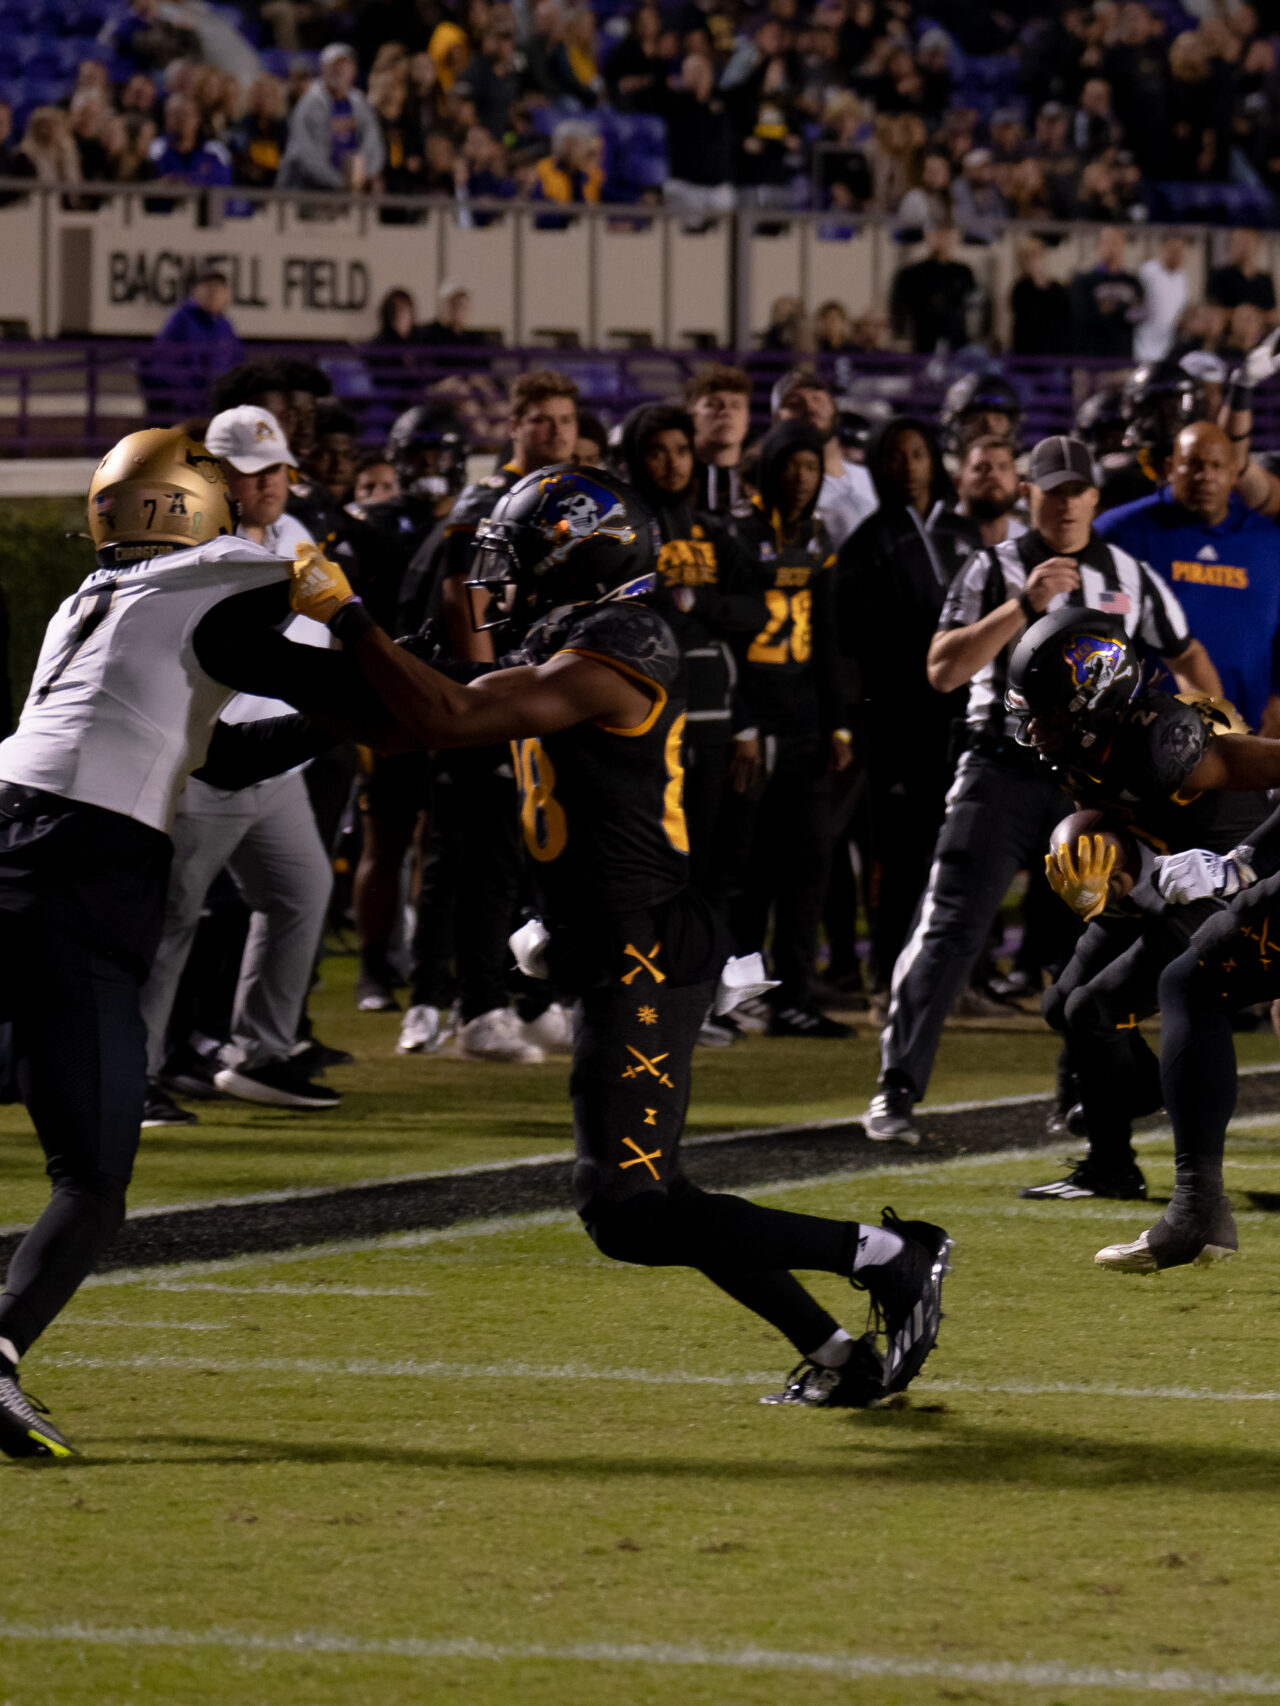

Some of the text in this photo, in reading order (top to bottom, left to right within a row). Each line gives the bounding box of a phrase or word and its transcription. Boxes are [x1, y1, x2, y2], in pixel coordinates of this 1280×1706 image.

[283, 256, 367, 310] FIELD
[143, 499, 156, 530] 7
[1171, 560, 1249, 589] PIRATES
[34, 578, 117, 706] 7
[509, 736, 568, 863] 8
